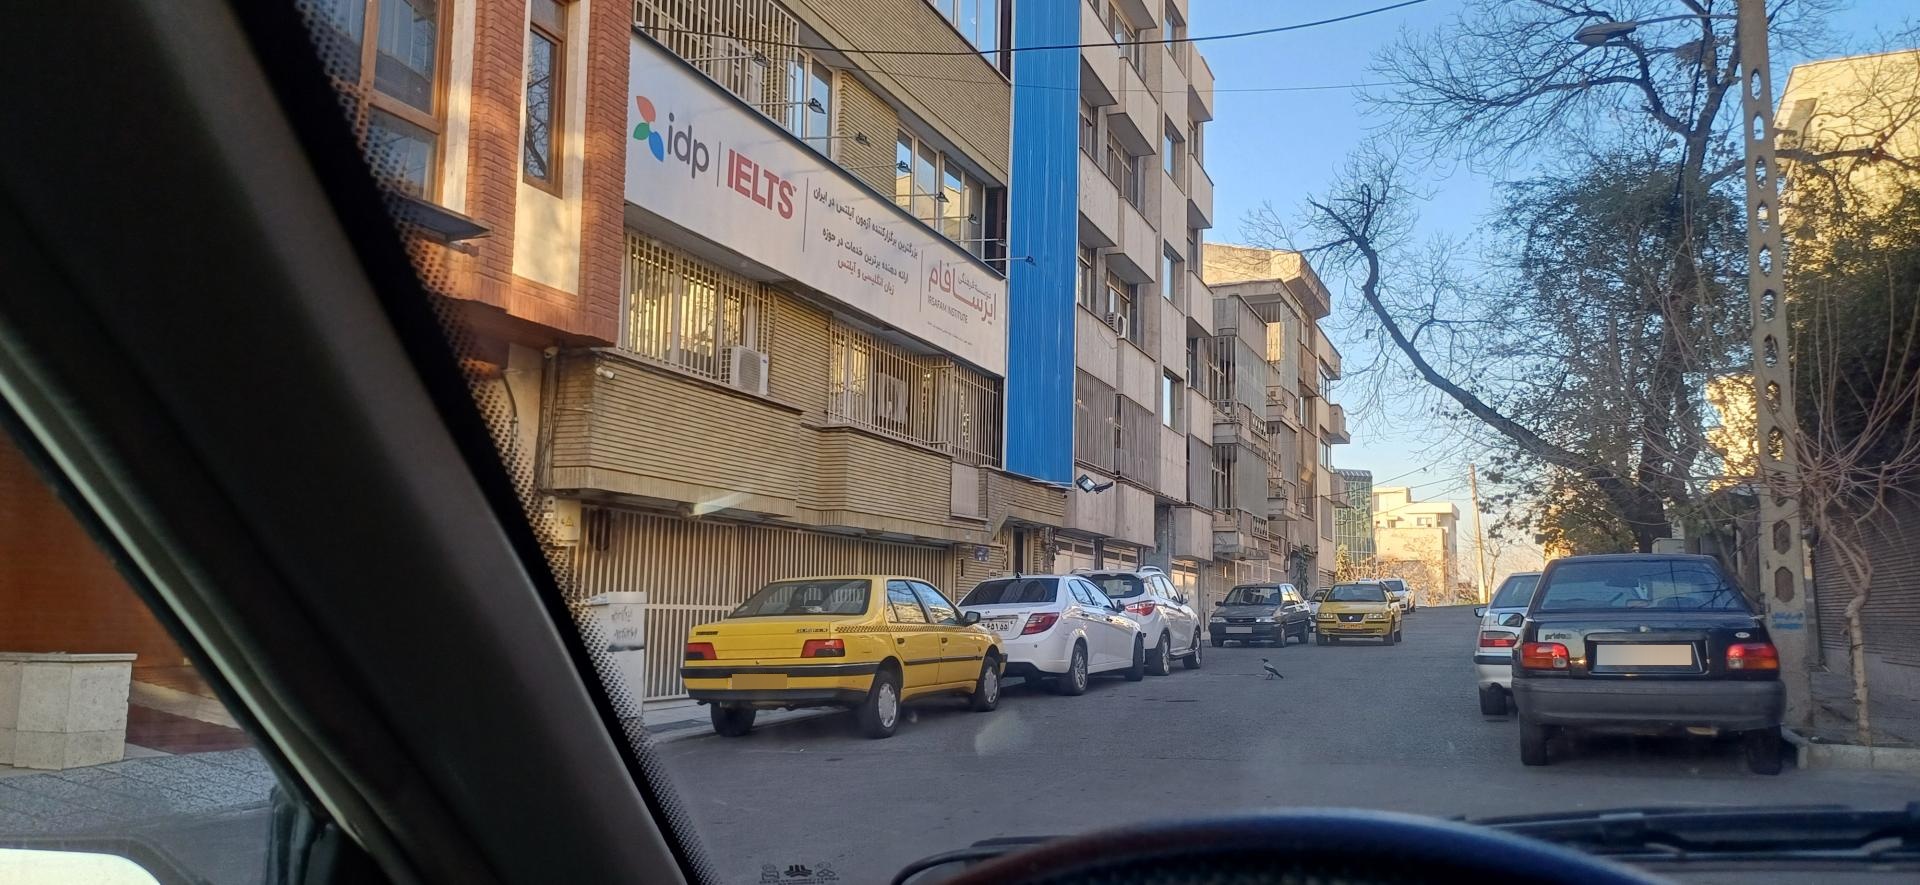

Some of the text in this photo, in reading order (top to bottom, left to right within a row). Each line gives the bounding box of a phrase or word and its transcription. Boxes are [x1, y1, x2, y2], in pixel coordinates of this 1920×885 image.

[667, 112, 709, 179] idp
[727, 148, 794, 220] IELTS
[813, 187, 828, 204] ایران
[828, 199, 835, 208] در
[836, 203, 855, 221] آیلتس
[855, 216, 871, 229] آزمون
[822, 228, 836, 241] حوزه
[836, 238, 844, 247] در
[844, 240, 863, 256] خدمات
[897, 242, 919, 260] بزرگترین
[864, 254, 881, 270] برترین
[881, 262, 897, 276] دهنده
[837, 258, 895, 295] زبان انگلیسی و آیلتس
[927, 294, 968, 324] IRSAFAM INSTITUTE
